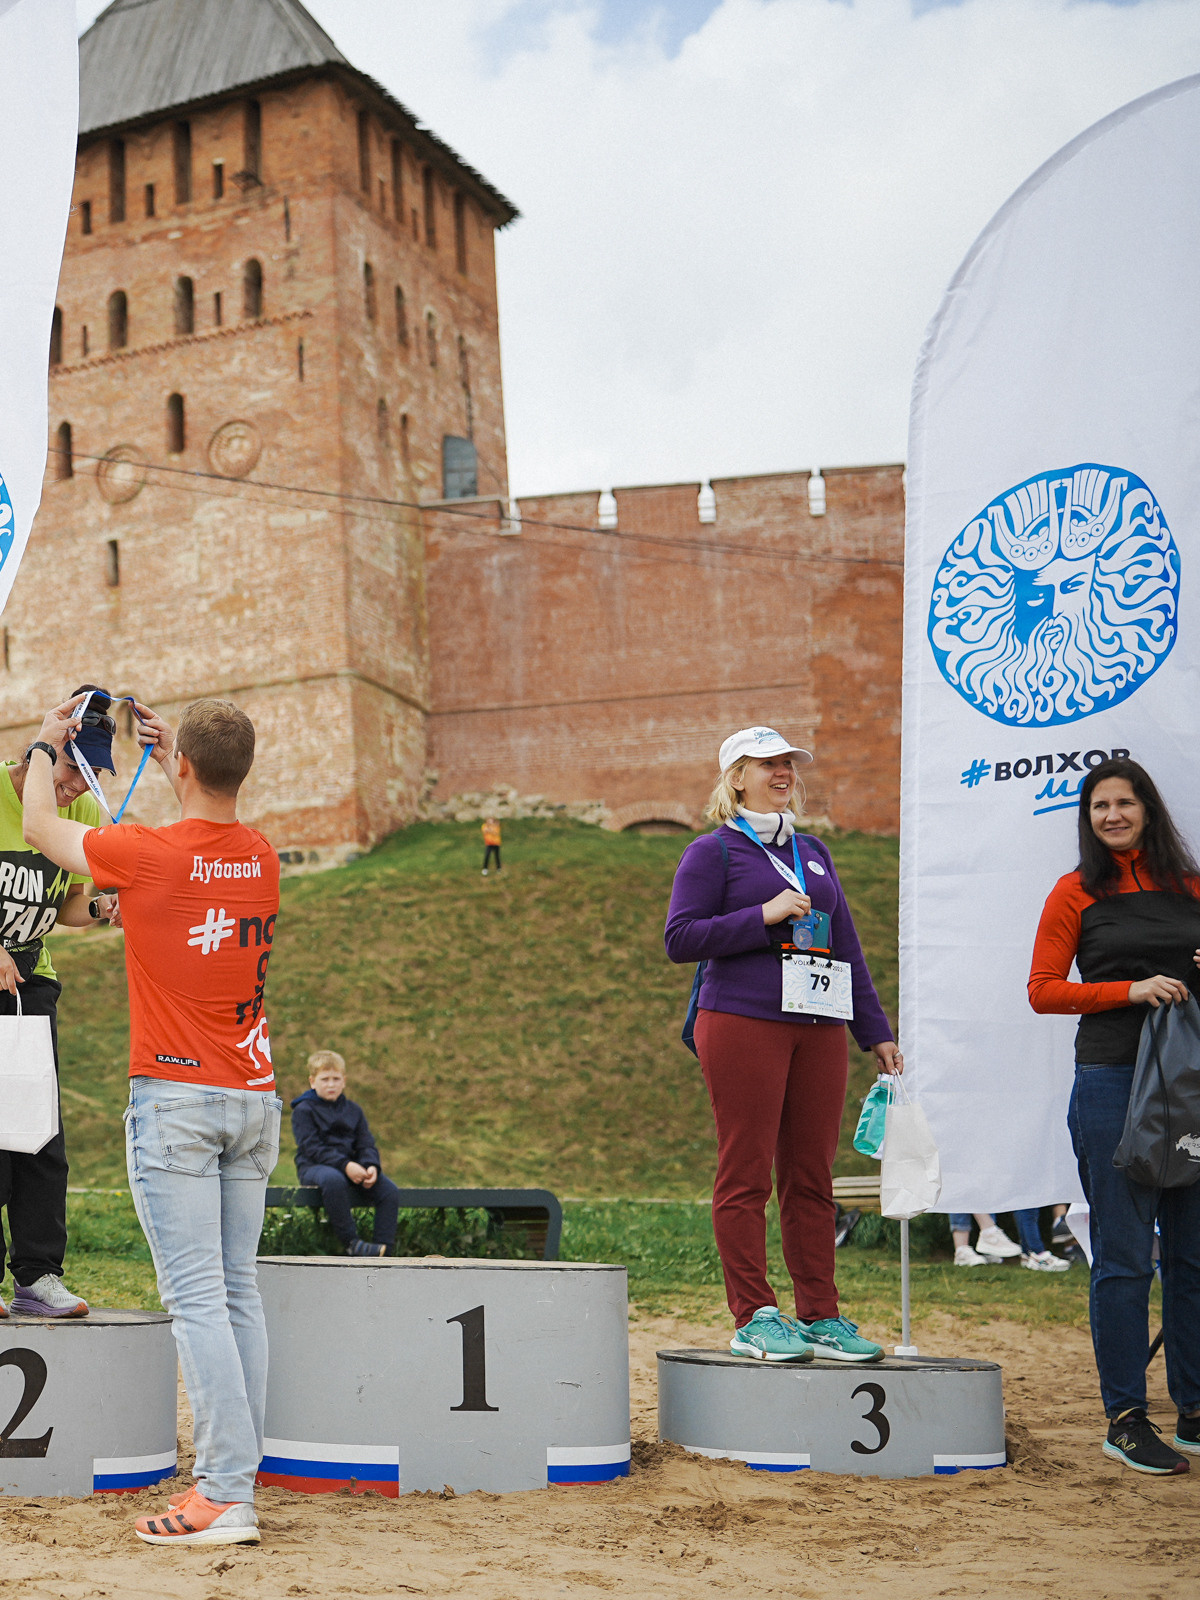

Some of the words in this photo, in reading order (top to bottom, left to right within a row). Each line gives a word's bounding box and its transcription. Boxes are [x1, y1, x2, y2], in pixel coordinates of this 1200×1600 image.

[189, 855, 262, 884] Дубовой
[810, 973, 831, 992] 79
[447, 1305, 499, 1411] 1
[851, 1382, 890, 1454] 3
